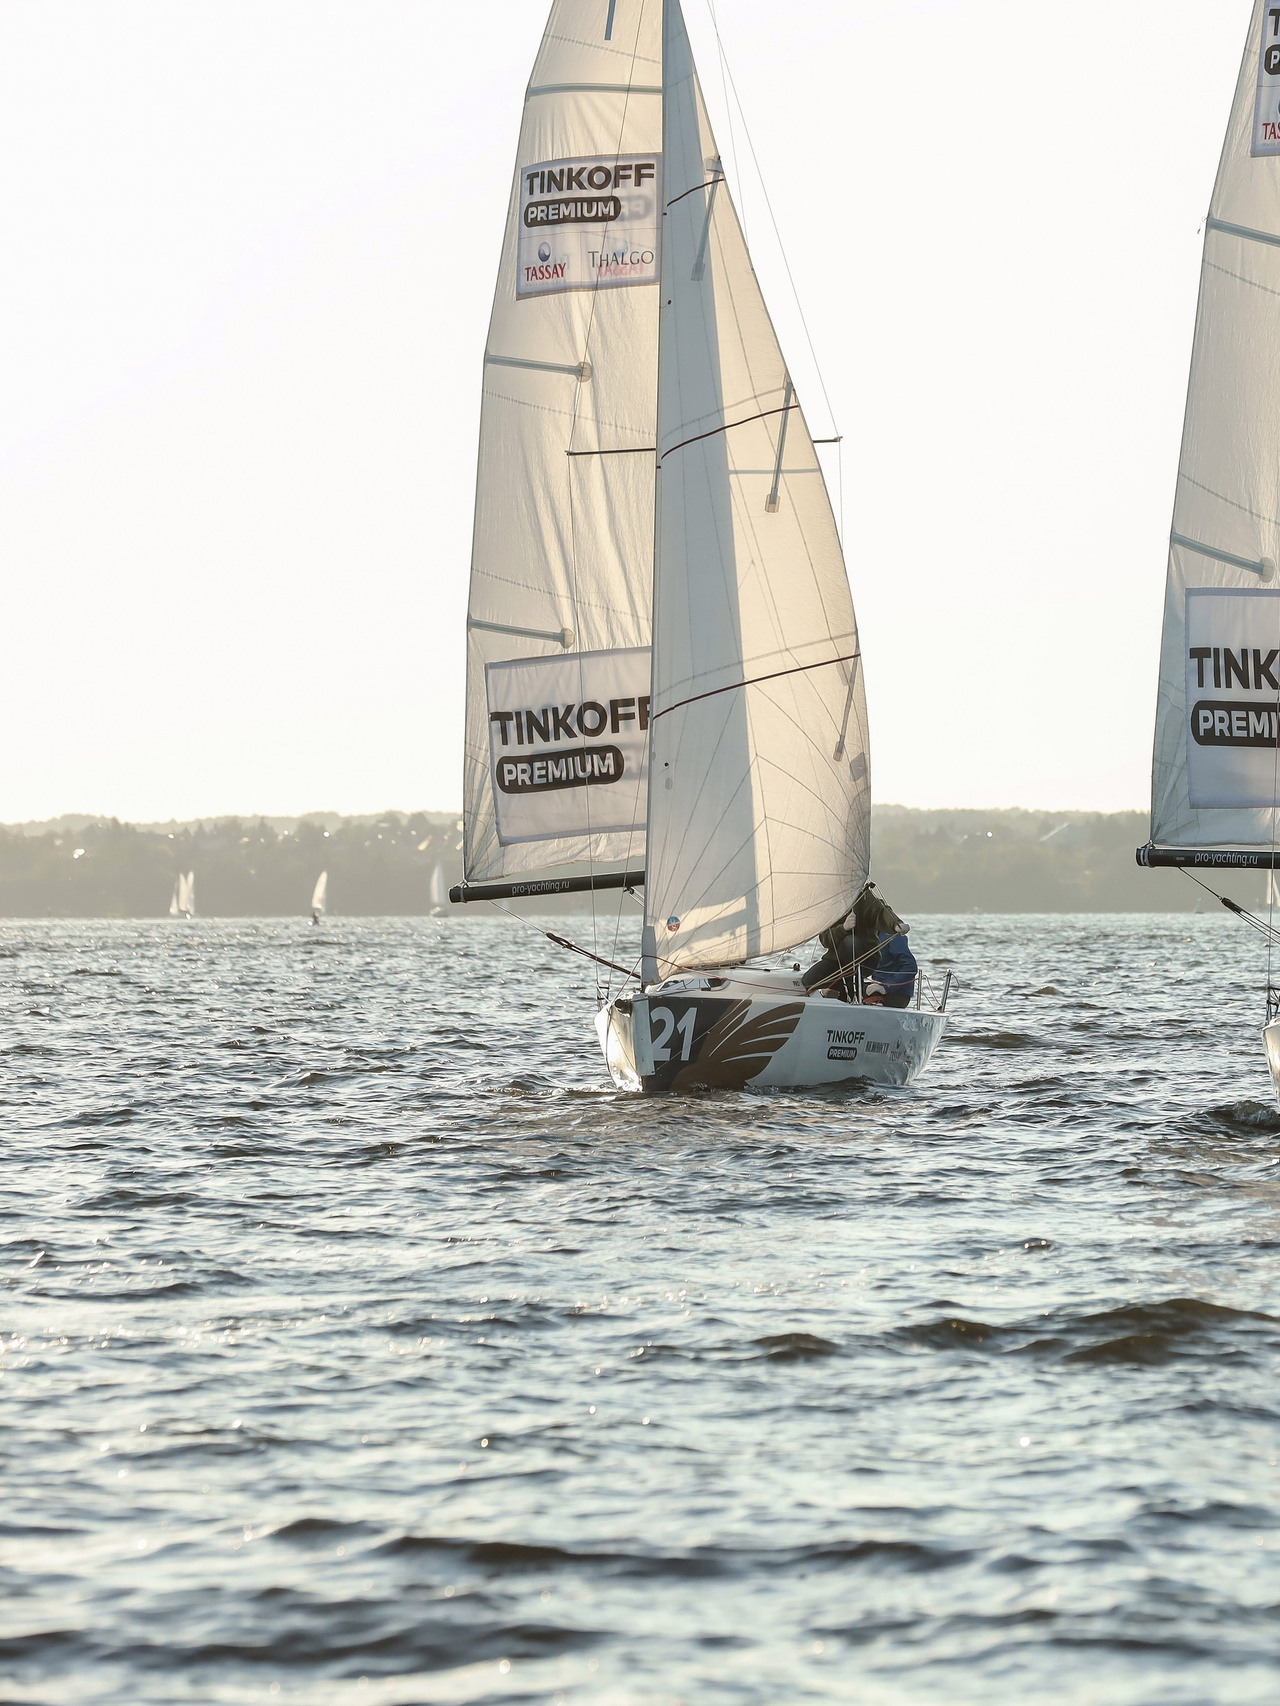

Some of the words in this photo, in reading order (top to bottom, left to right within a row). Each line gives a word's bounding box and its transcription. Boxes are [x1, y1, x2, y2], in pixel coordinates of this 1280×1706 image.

[526, 163, 656, 196] TINKOFF
[527, 200, 616, 223] PREMIUM
[587, 250, 655, 269] THALGO
[524, 262, 567, 282] TASSAY
[503, 752, 616, 787] PREMIUM
[1194, 851, 1259, 866] pro-yachting.ru
[511, 880, 570, 896] pro-yachting.ru
[650, 1006, 698, 1061] 21
[826, 1029, 866, 1045] TINKOFF
[828, 1048, 857, 1059] PREMIUM
